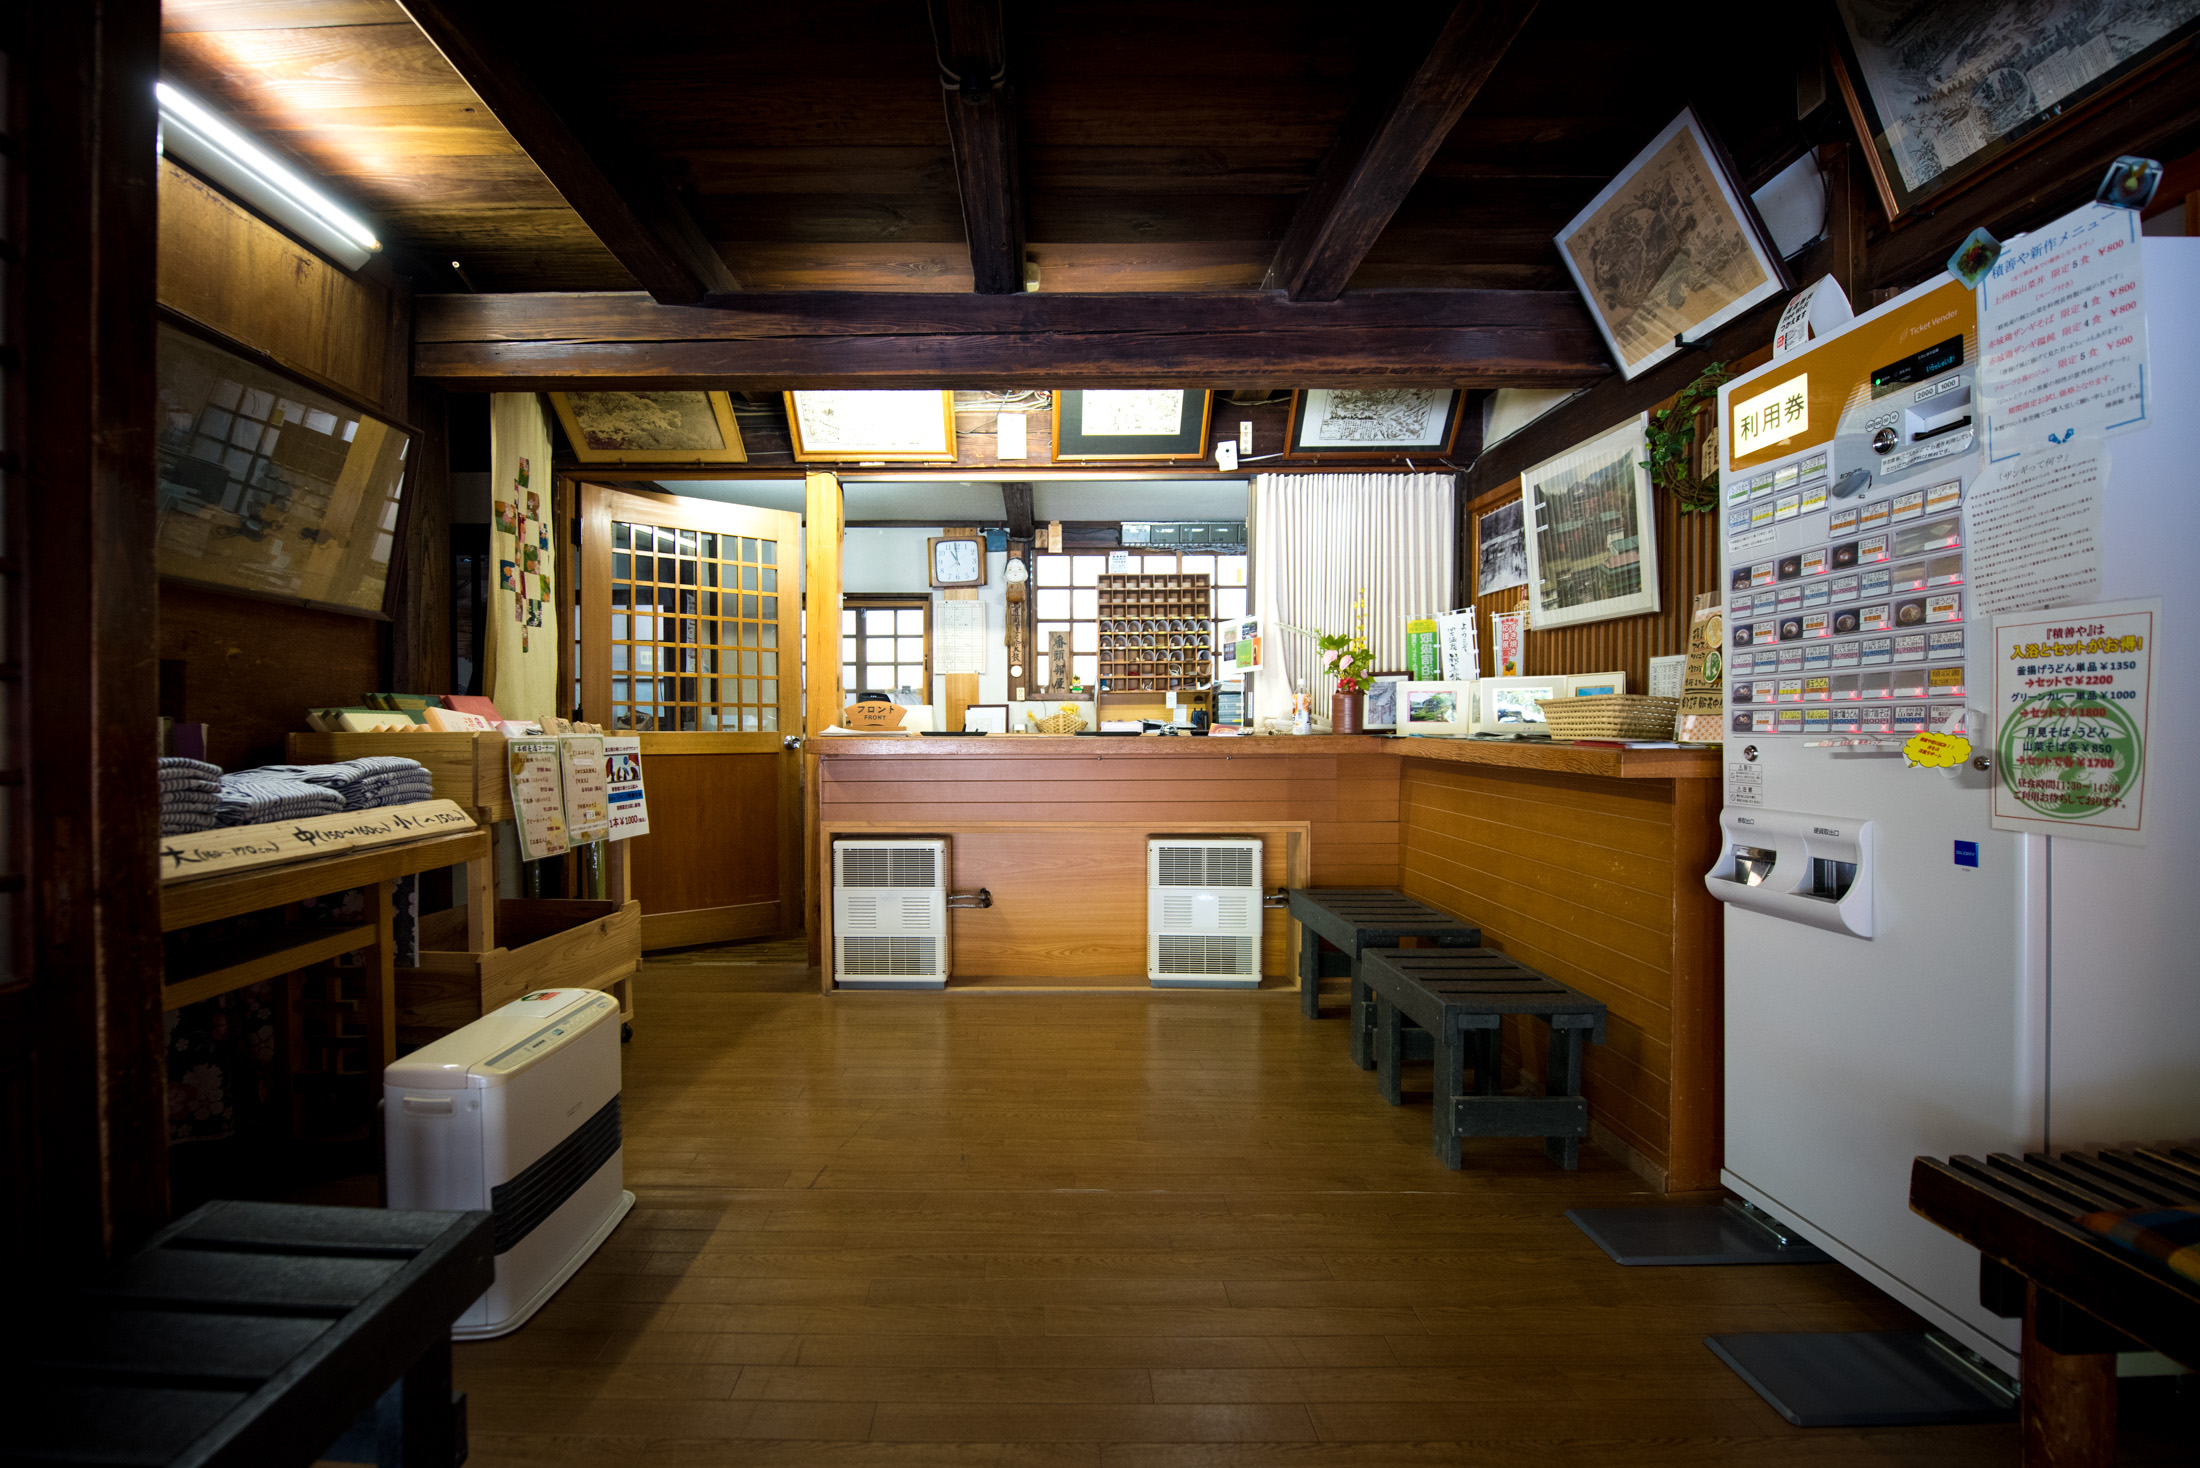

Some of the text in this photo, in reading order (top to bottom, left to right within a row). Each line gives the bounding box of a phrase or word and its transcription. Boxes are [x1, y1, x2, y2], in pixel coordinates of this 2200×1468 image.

[1991, 211, 2116, 280] 積善や新作メニュー
[1994, 275, 2046, 306] 上州豚山菜丼
[1910, 309, 1958, 336] Ticket Vender
[1917, 379, 1956, 399] 2000 1000
[1741, 392, 1805, 441] 利用券
[1929, 596, 1957, 607] 山菜うどん
[1862, 606, 1887, 617] 山菜そば
[1509, 623, 1519, 657] すき焼き
[2046, 624, 2105, 640] 『積善や』は
[1052, 635, 1068, 691] 番頭部屋
[1782, 681, 1799, 689] コーヒー
[857, 705, 895, 714] フロント
[2026, 727, 2109, 738] 月見そば・うどん
[2013, 791, 2127, 809] ご利用お待ちしております。
[1737, 817, 1754, 825] 券取出口
[1813, 827, 1839, 837] 硬貨取出口
